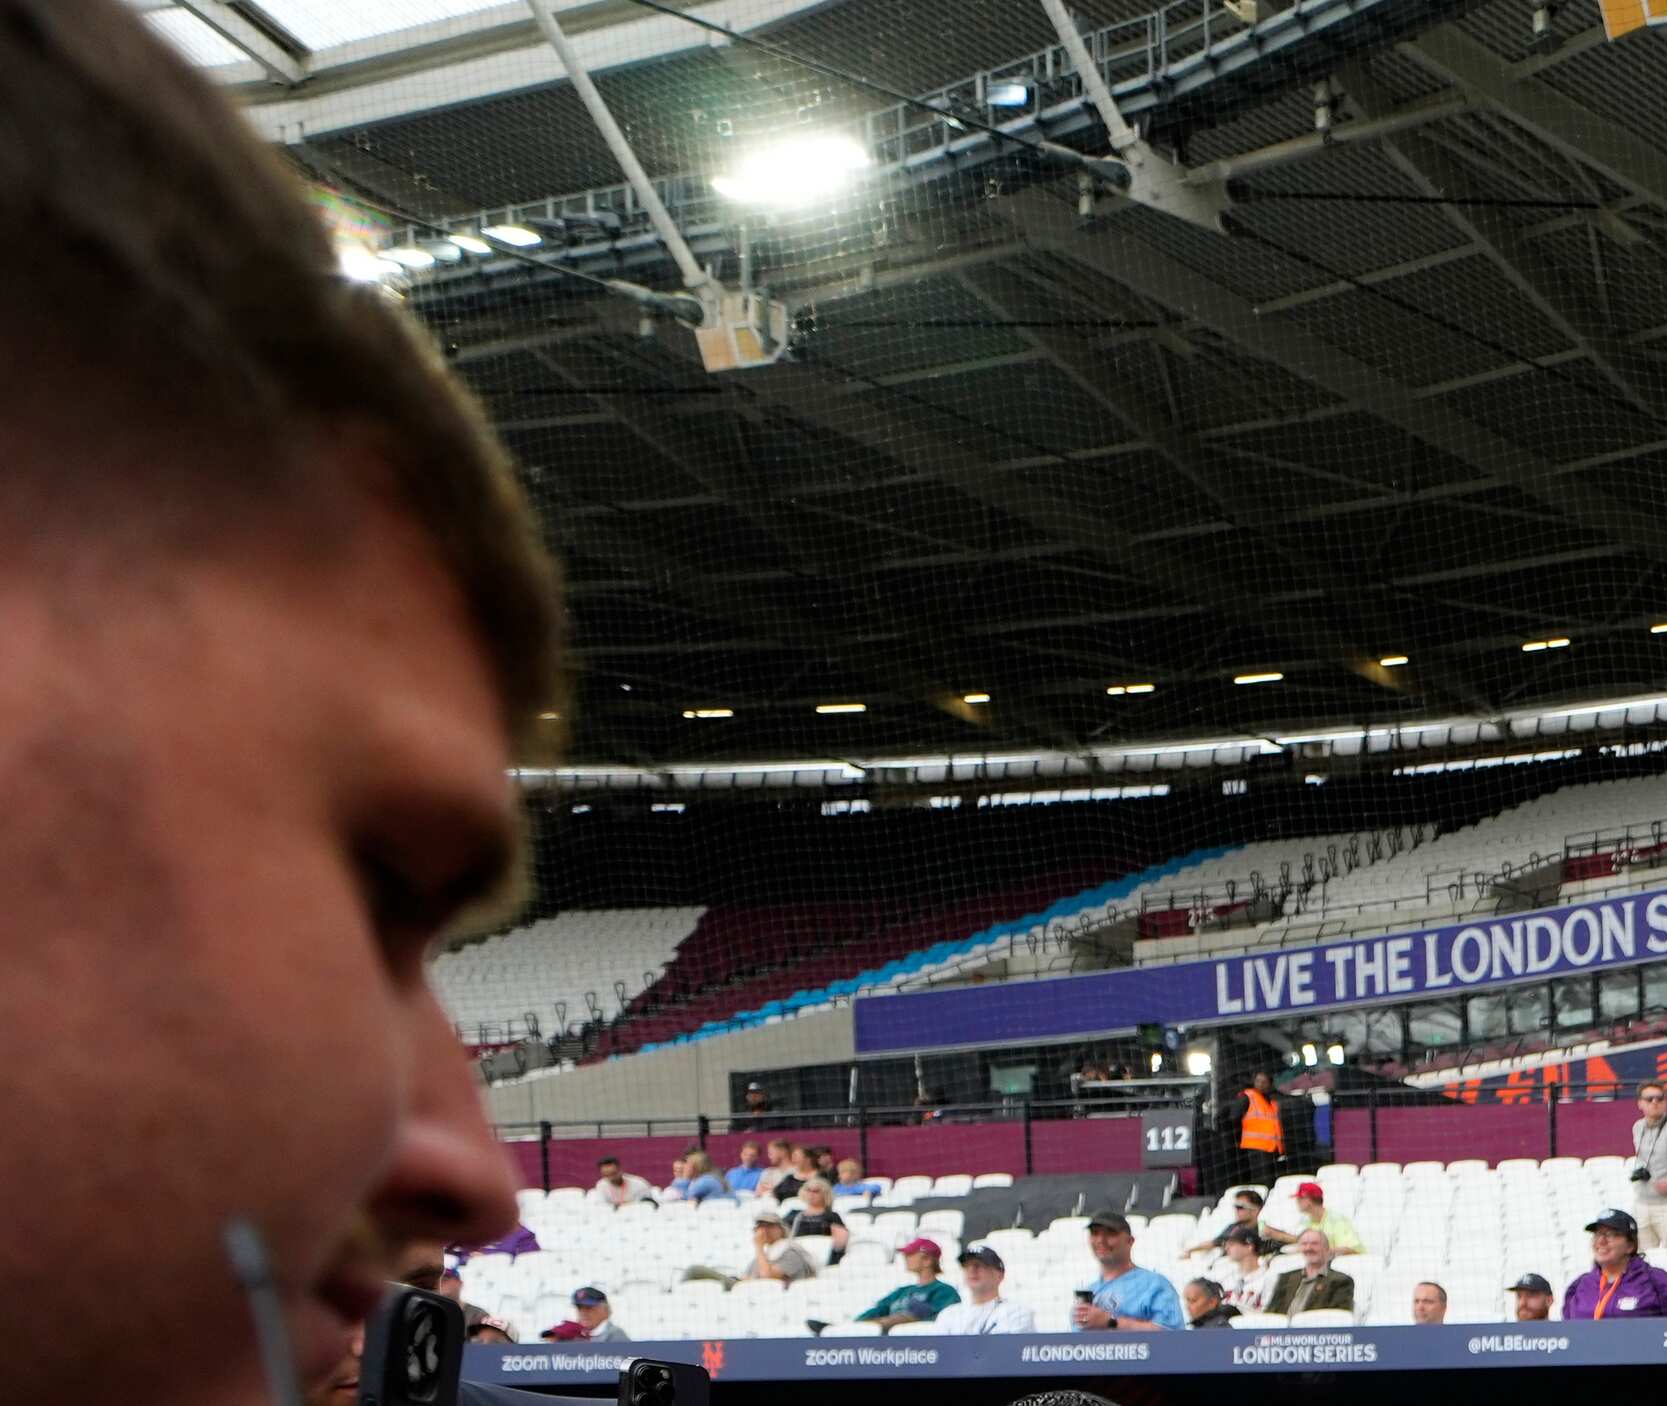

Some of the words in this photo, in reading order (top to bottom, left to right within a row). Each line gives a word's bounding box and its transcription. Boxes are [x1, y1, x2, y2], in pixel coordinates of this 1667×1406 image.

[1215, 960, 1314, 1015] LIVE
[1326, 939, 1414, 999] THE
[1425, 899, 1635, 989] LONDON
[1146, 1126, 1190, 1151] 112
[1022, 1344, 1148, 1362] #LONDONSERIES
[1468, 1335, 1569, 1354] @MLBEurope
[502, 1355, 548, 1371] zoom
[806, 1349, 854, 1366] zoom
[858, 1348, 937, 1367] Workplace
[1233, 1346, 1312, 1365] LONDON
[1314, 1344, 1377, 1363] SERIES
